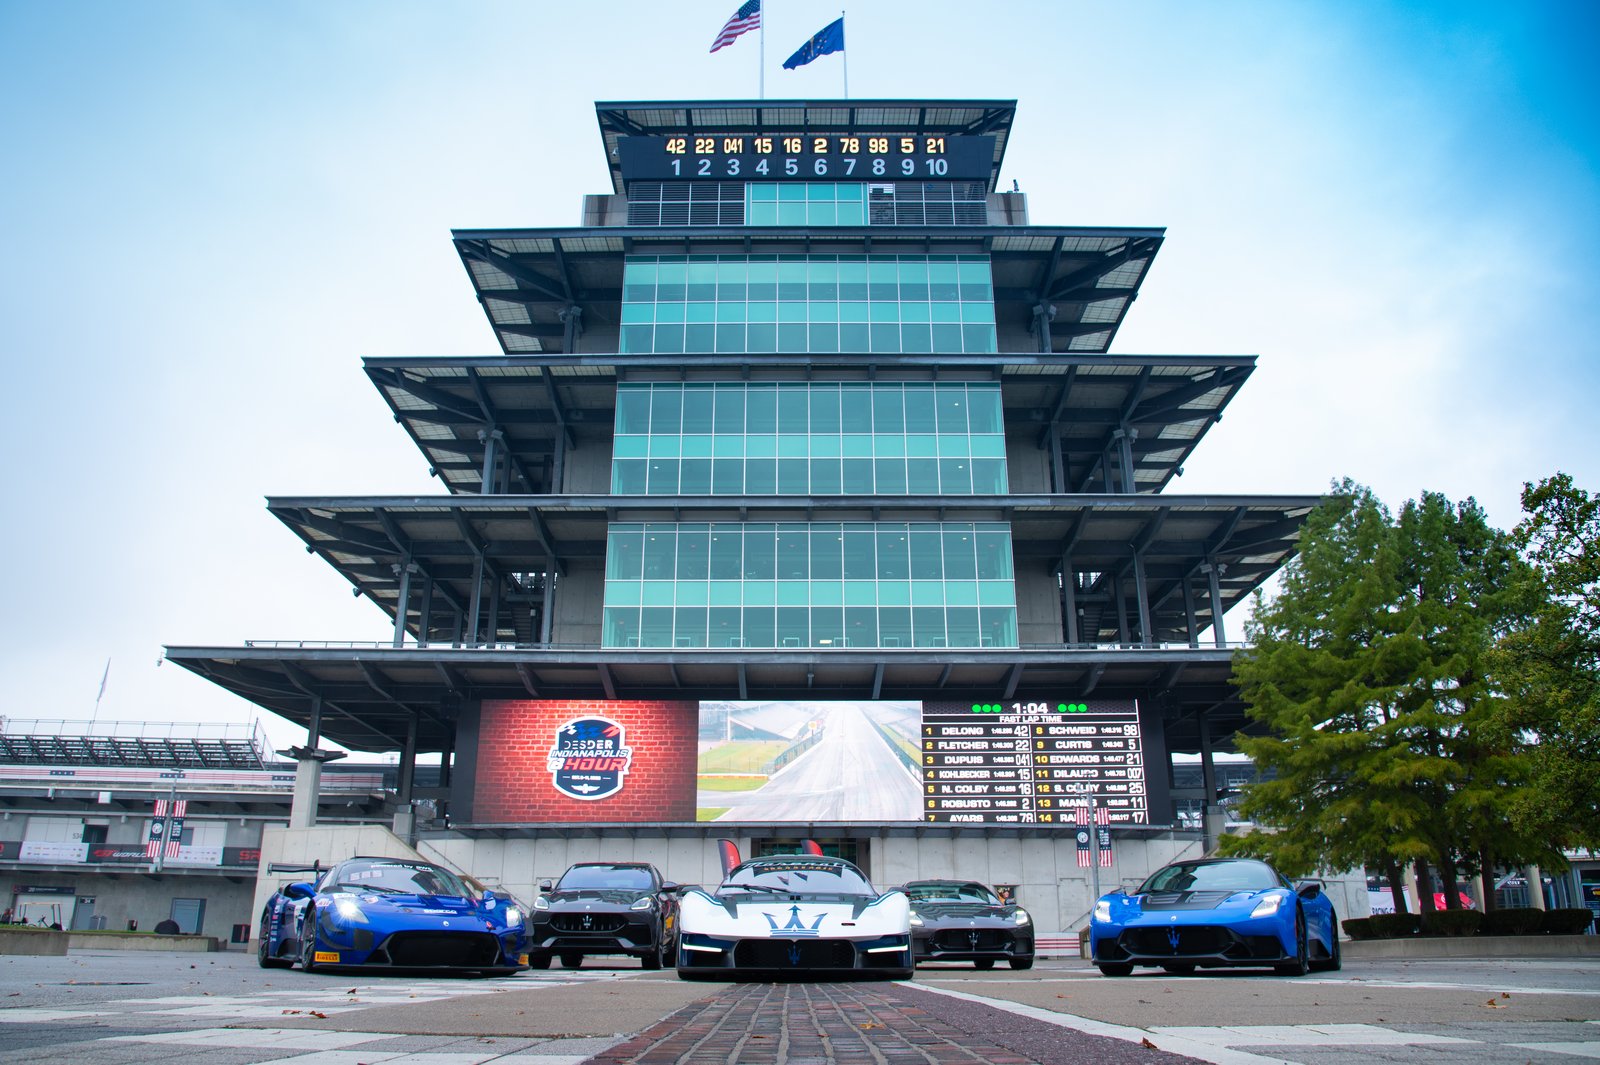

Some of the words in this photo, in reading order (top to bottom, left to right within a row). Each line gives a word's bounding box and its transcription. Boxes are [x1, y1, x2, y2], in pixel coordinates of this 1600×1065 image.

[666, 138, 686, 153] 42
[695, 138, 715, 153] 22
[723, 138, 743, 153] 041
[754, 138, 773, 153] 15
[783, 138, 802, 153] 16
[814, 138, 828, 153] 2
[839, 138, 860, 153] 78
[868, 138, 889, 153] 98
[900, 138, 914, 153] 5
[926, 138, 945, 153] 21
[671, 159, 681, 175] 1
[697, 158, 711, 175] 2
[727, 158, 740, 175] 3
[755, 158, 770, 175] 4
[785, 158, 799, 175] 5
[814, 158, 828, 175] 6
[843, 158, 857, 174] 7
[872, 158, 886, 175] 8
[901, 158, 915, 175] 9
[925, 158, 948, 175] 10
[1012, 703, 1048, 714] 1:04
[925, 727, 932, 735] 1
[942, 727, 983, 735] DELONG
[1014, 726, 1028, 736] 42
[1035, 726, 1043, 735] 8
[1124, 725, 1137, 736] 98
[926, 741, 934, 750] 2
[1015, 740, 1029, 751] 22
[1036, 741, 1044, 749] 9
[1128, 739, 1136, 750] 5
[550, 750, 629, 758] INDIANAPOLIS
[1050, 755, 1100, 763] EDWARDS
[1126, 753, 1139, 764] 21
[564, 758, 627, 771] HOUR
[925, 755, 935, 764] 3
[944, 755, 984, 764] DUPUIS
[1016, 754, 1030, 766] 041
[926, 770, 935, 779] 4
[1018, 769, 1030, 780] 15
[1127, 768, 1142, 779] 007
[927, 785, 935, 794] 5
[955, 785, 989, 793] COLBY
[1019, 783, 1031, 795] 16
[1129, 782, 1143, 794] 25
[927, 799, 936, 808] 6
[942, 800, 991, 808] ROBUSTO
[1022, 798, 1029, 809] 2
[1131, 797, 1144, 809] 11
[928, 814, 936, 822] 7
[1019, 813, 1033, 822] 78
[1132, 812, 1144, 823] 17
